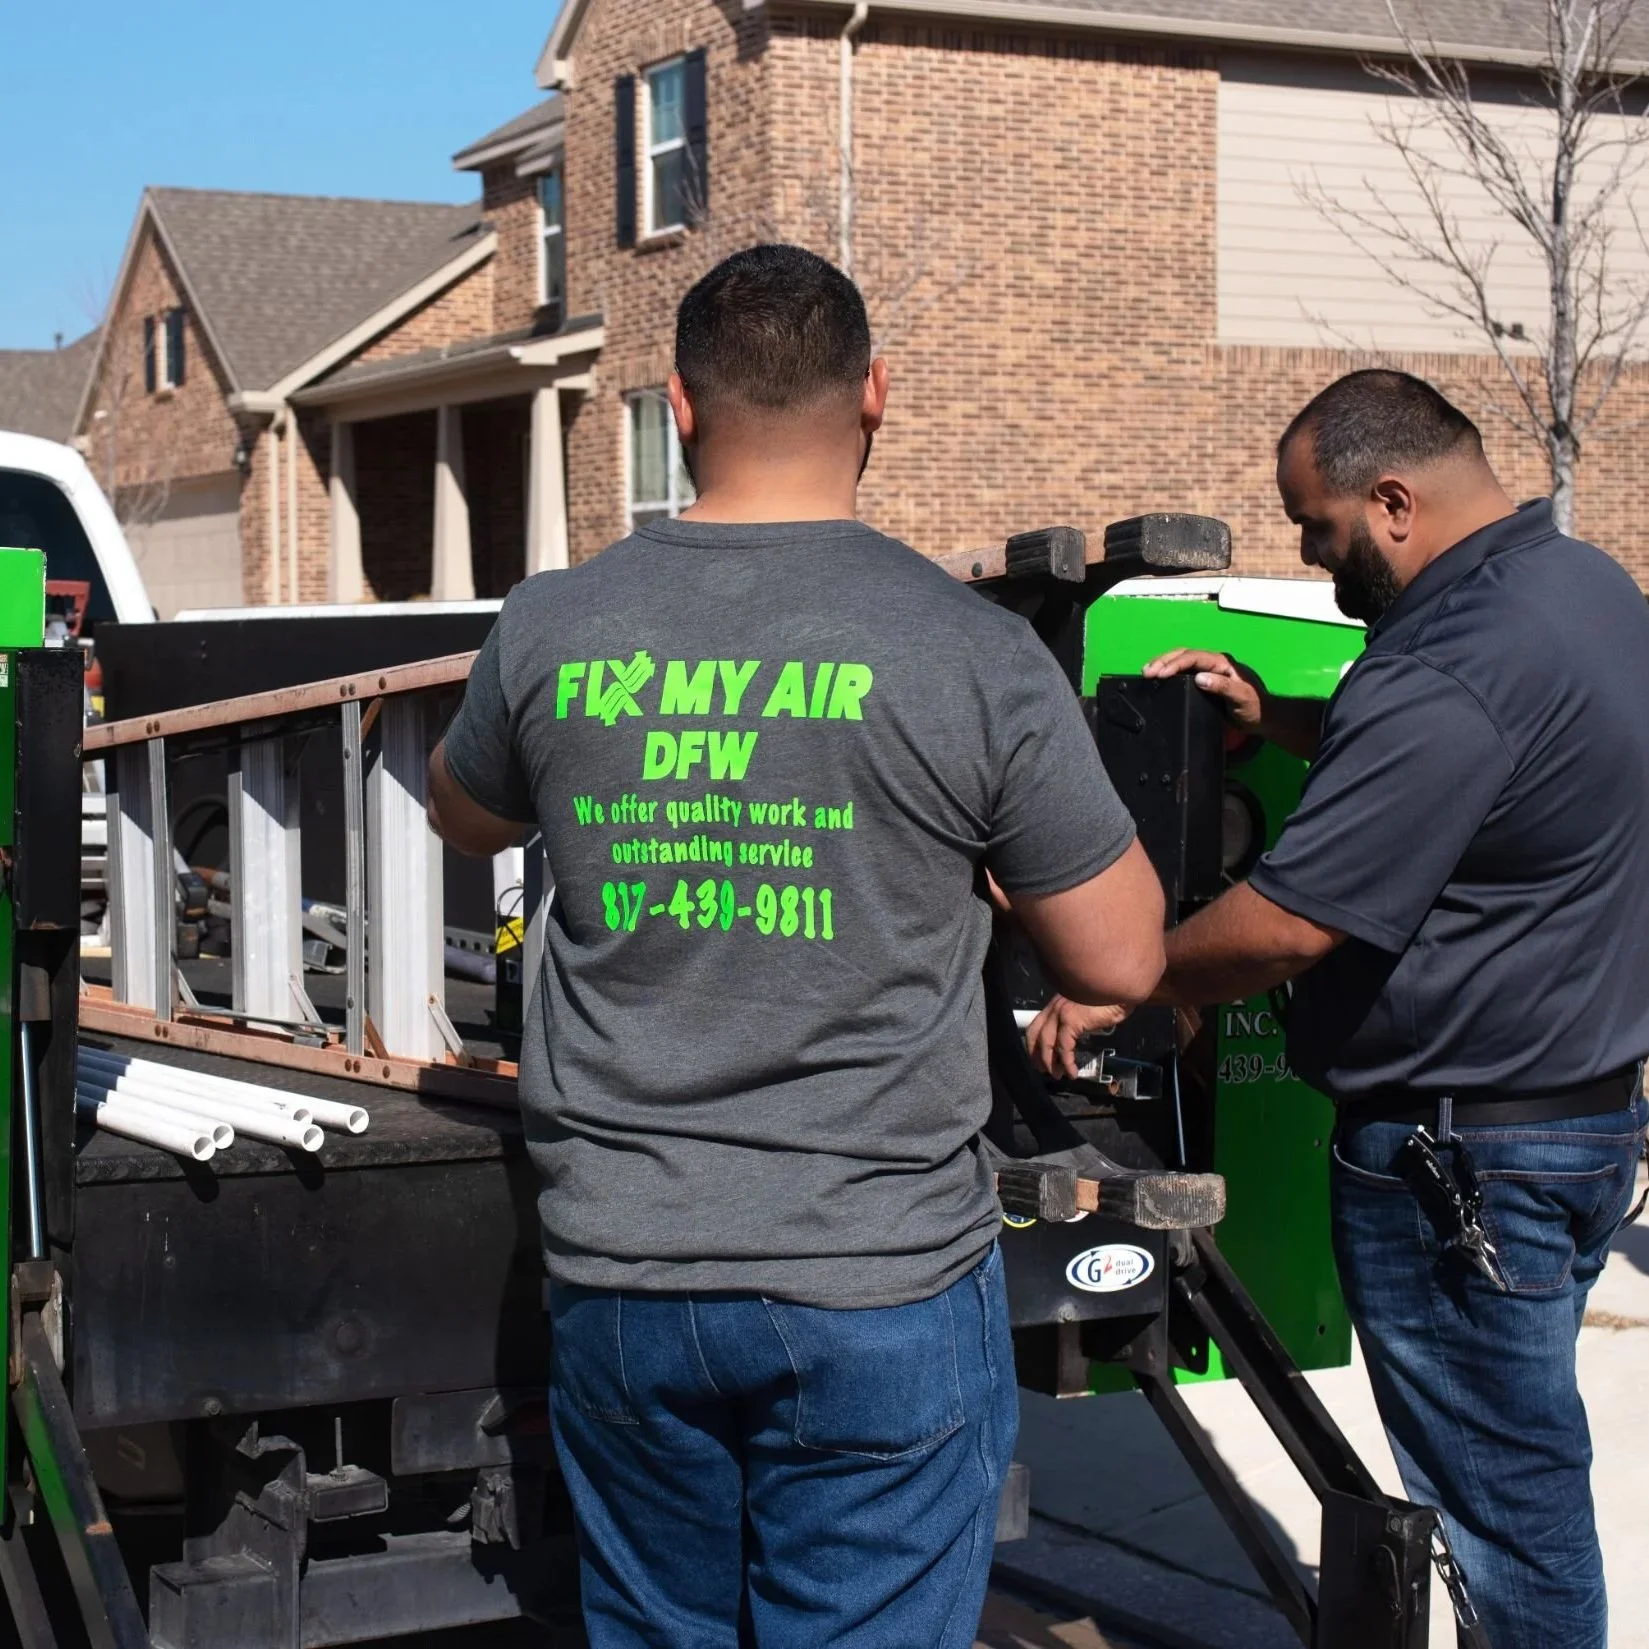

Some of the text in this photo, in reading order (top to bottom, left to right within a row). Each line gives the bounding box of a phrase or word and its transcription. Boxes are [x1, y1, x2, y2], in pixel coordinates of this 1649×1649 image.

[555, 650, 874, 727] FIX MY AIR
[642, 730, 760, 781] DFW
[573, 793, 854, 831] We offer quality work and
[612, 835, 814, 869] outstanding service
[602, 879, 835, 942] 817-439-9811
[1225, 1010, 1278, 1037] INC.
[1217, 1053, 1301, 1084] 439-9
[1115, 1258, 1134, 1267] dual
[1115, 1267, 1137, 1275] drive
